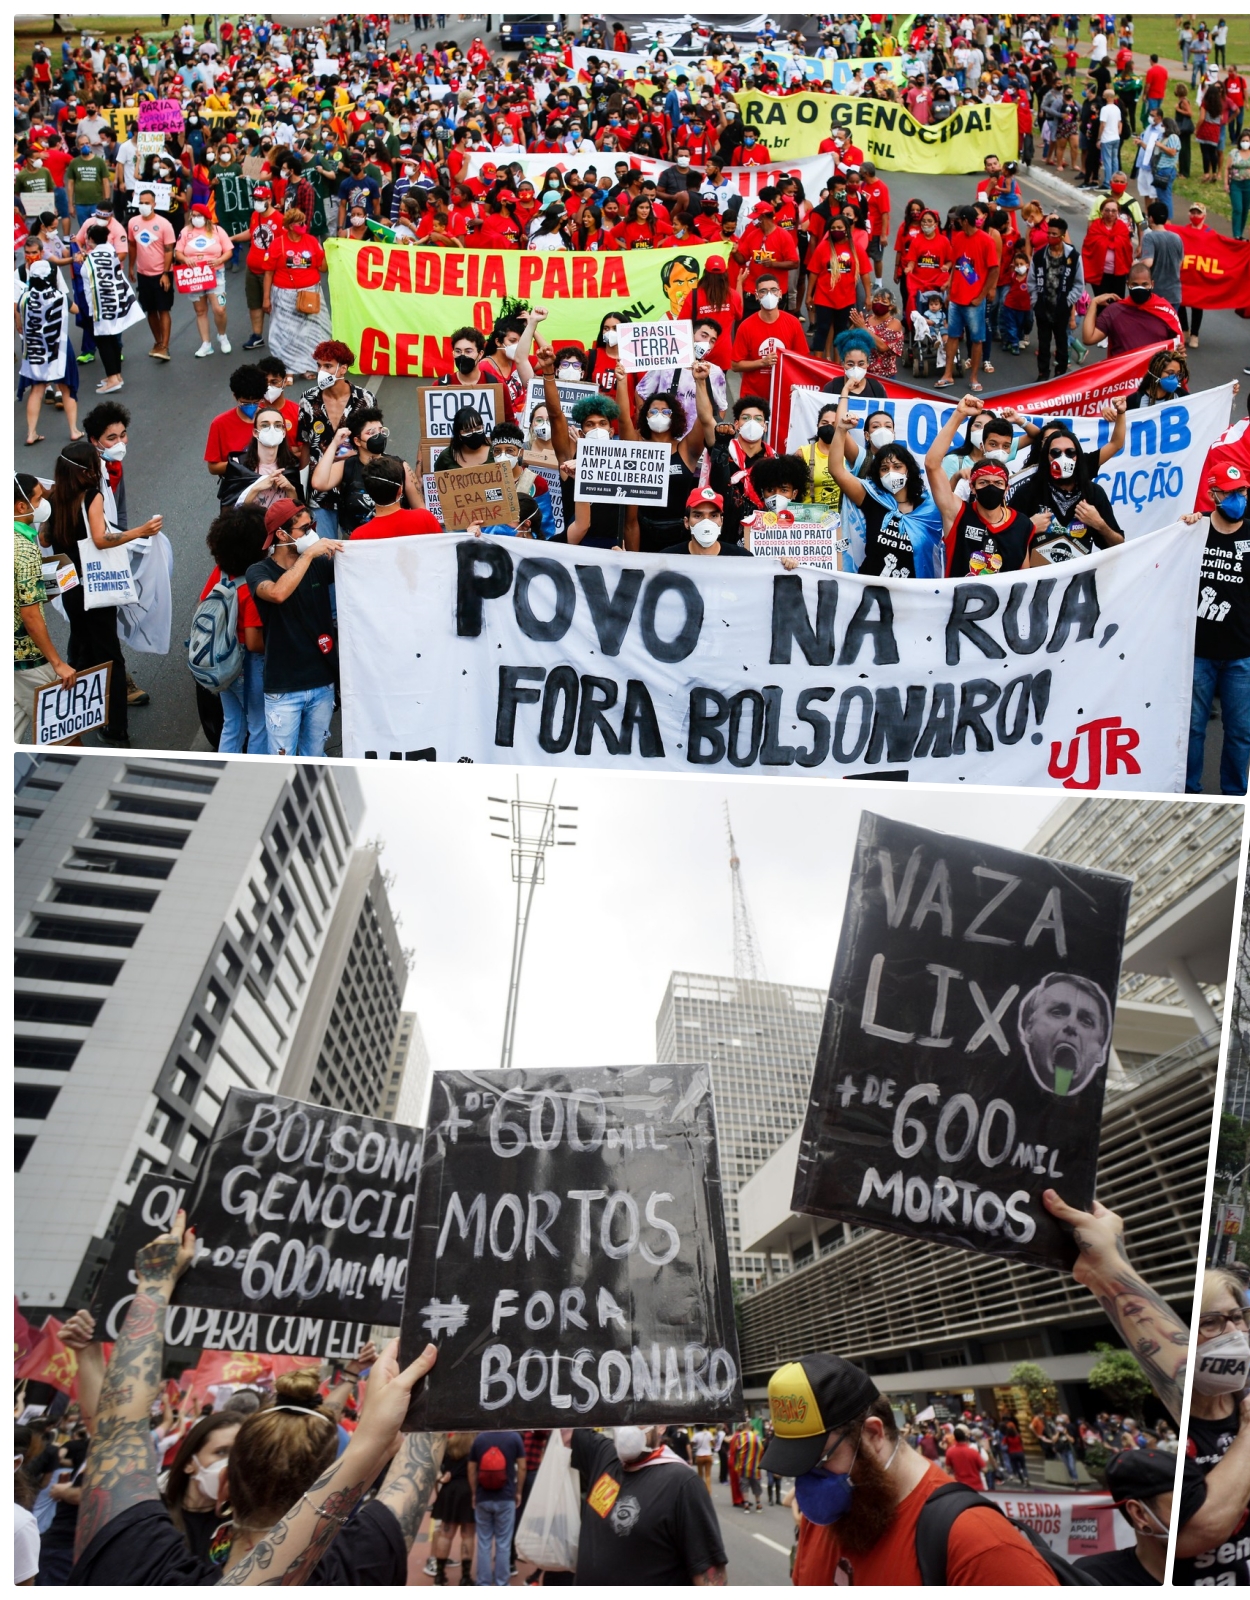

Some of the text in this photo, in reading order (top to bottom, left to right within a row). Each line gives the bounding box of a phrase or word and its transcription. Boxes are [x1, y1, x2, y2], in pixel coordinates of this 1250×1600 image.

[739, 99, 993, 144] RA O GENOCIDA!
[867, 140, 895, 158] FNL
[176, 264, 213, 280] FORA
[355, 245, 631, 300] CADEIA PARA
[1181, 253, 1224, 275] FNL
[93, 251, 118, 321] BOLSONARO
[177, 275, 215, 287] BOLSONARO
[632, 325, 676, 338] BRASIL
[631, 338, 680, 357] TERRA
[634, 355, 678, 366] INDÍGENA
[566, 390, 575, 401] DA
[1027, 392, 1083, 411] GENOCÍDIO
[1085, 391, 1091, 400] E
[1101, 377, 1144, 396] FASCISM
[428, 392, 494, 422] FORA
[430, 423, 492, 438] GENA
[582, 445, 666, 460] NENHUMA FRENTE
[581, 457, 665, 473] AMPLA COM
[580, 469, 664, 485] OS NEOLIBERAIS
[1093, 461, 1184, 513] CAÇÃO
[454, 491, 484, 509] ERA
[453, 505, 503, 527] MATAR
[754, 529, 832, 540] COMIDA NO PRATO
[876, 535, 898, 548] fora
[754, 546, 786, 556] VACINA
[788, 546, 800, 556] NO
[803, 545, 833, 558] BRAÇO
[1203, 546, 1233, 559] acina
[86, 560, 102, 572] MEU
[1201, 558, 1242, 573] uxílio &
[94, 580, 131, 593] FEMINISTA
[1216, 571, 1244, 584] bozo
[455, 539, 1119, 667] POVO NA RUA,
[41, 673, 105, 727] FORA
[41, 707, 103, 743] GENOCIDA
[494, 663, 1053, 768] FORA BOLSONARO!
[1047, 715, 1142, 791] UJR
[877, 844, 1068, 958] VAZA
[464, 1090, 496, 1111] DE
[490, 1086, 607, 1159] 600
[606, 1123, 668, 1152] MIL
[863, 1072, 897, 1108] DE
[892, 1082, 1017, 1168] 600
[1010, 1143, 1064, 1179] MIL
[241, 1101, 422, 1183] BOLSONA
[220, 1164, 416, 1240] GENOCID
[857, 1166, 1037, 1244] MORTOS
[435, 1189, 681, 1266] MORTOS
[241, 1231, 331, 1301] 600
[491, 1285, 627, 1335] FORA
[105, 1293, 258, 1352] COPERA
[266, 1315, 318, 1355] COM
[1199, 1356, 1247, 1377] FORA
[479, 1341, 738, 1414] BOLSONARO
[1004, 1501, 1062, 1519] E RENDA
[1021, 1519, 1062, 1535] ODOS
[1070, 1524, 1098, 1533] APOIO
